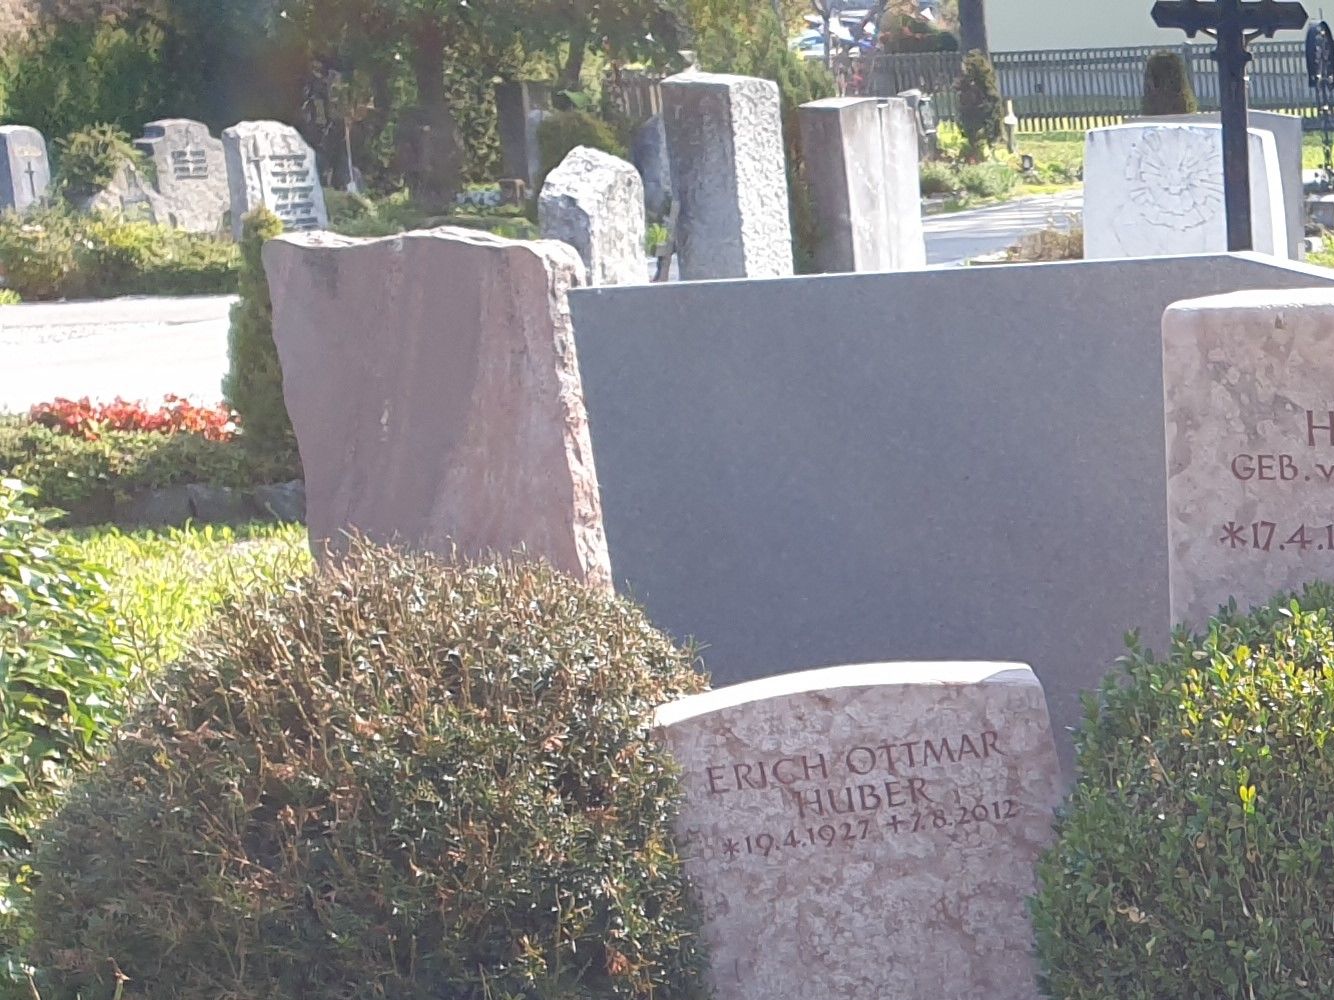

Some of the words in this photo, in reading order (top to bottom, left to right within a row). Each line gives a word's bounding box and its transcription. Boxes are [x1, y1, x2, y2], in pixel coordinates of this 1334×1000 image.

[1230, 453, 1311, 482] GEB.
[706, 753, 829, 795] ERICH
[846, 730, 1008, 776] OTTMAR
[799, 777, 935, 819] HUBER
